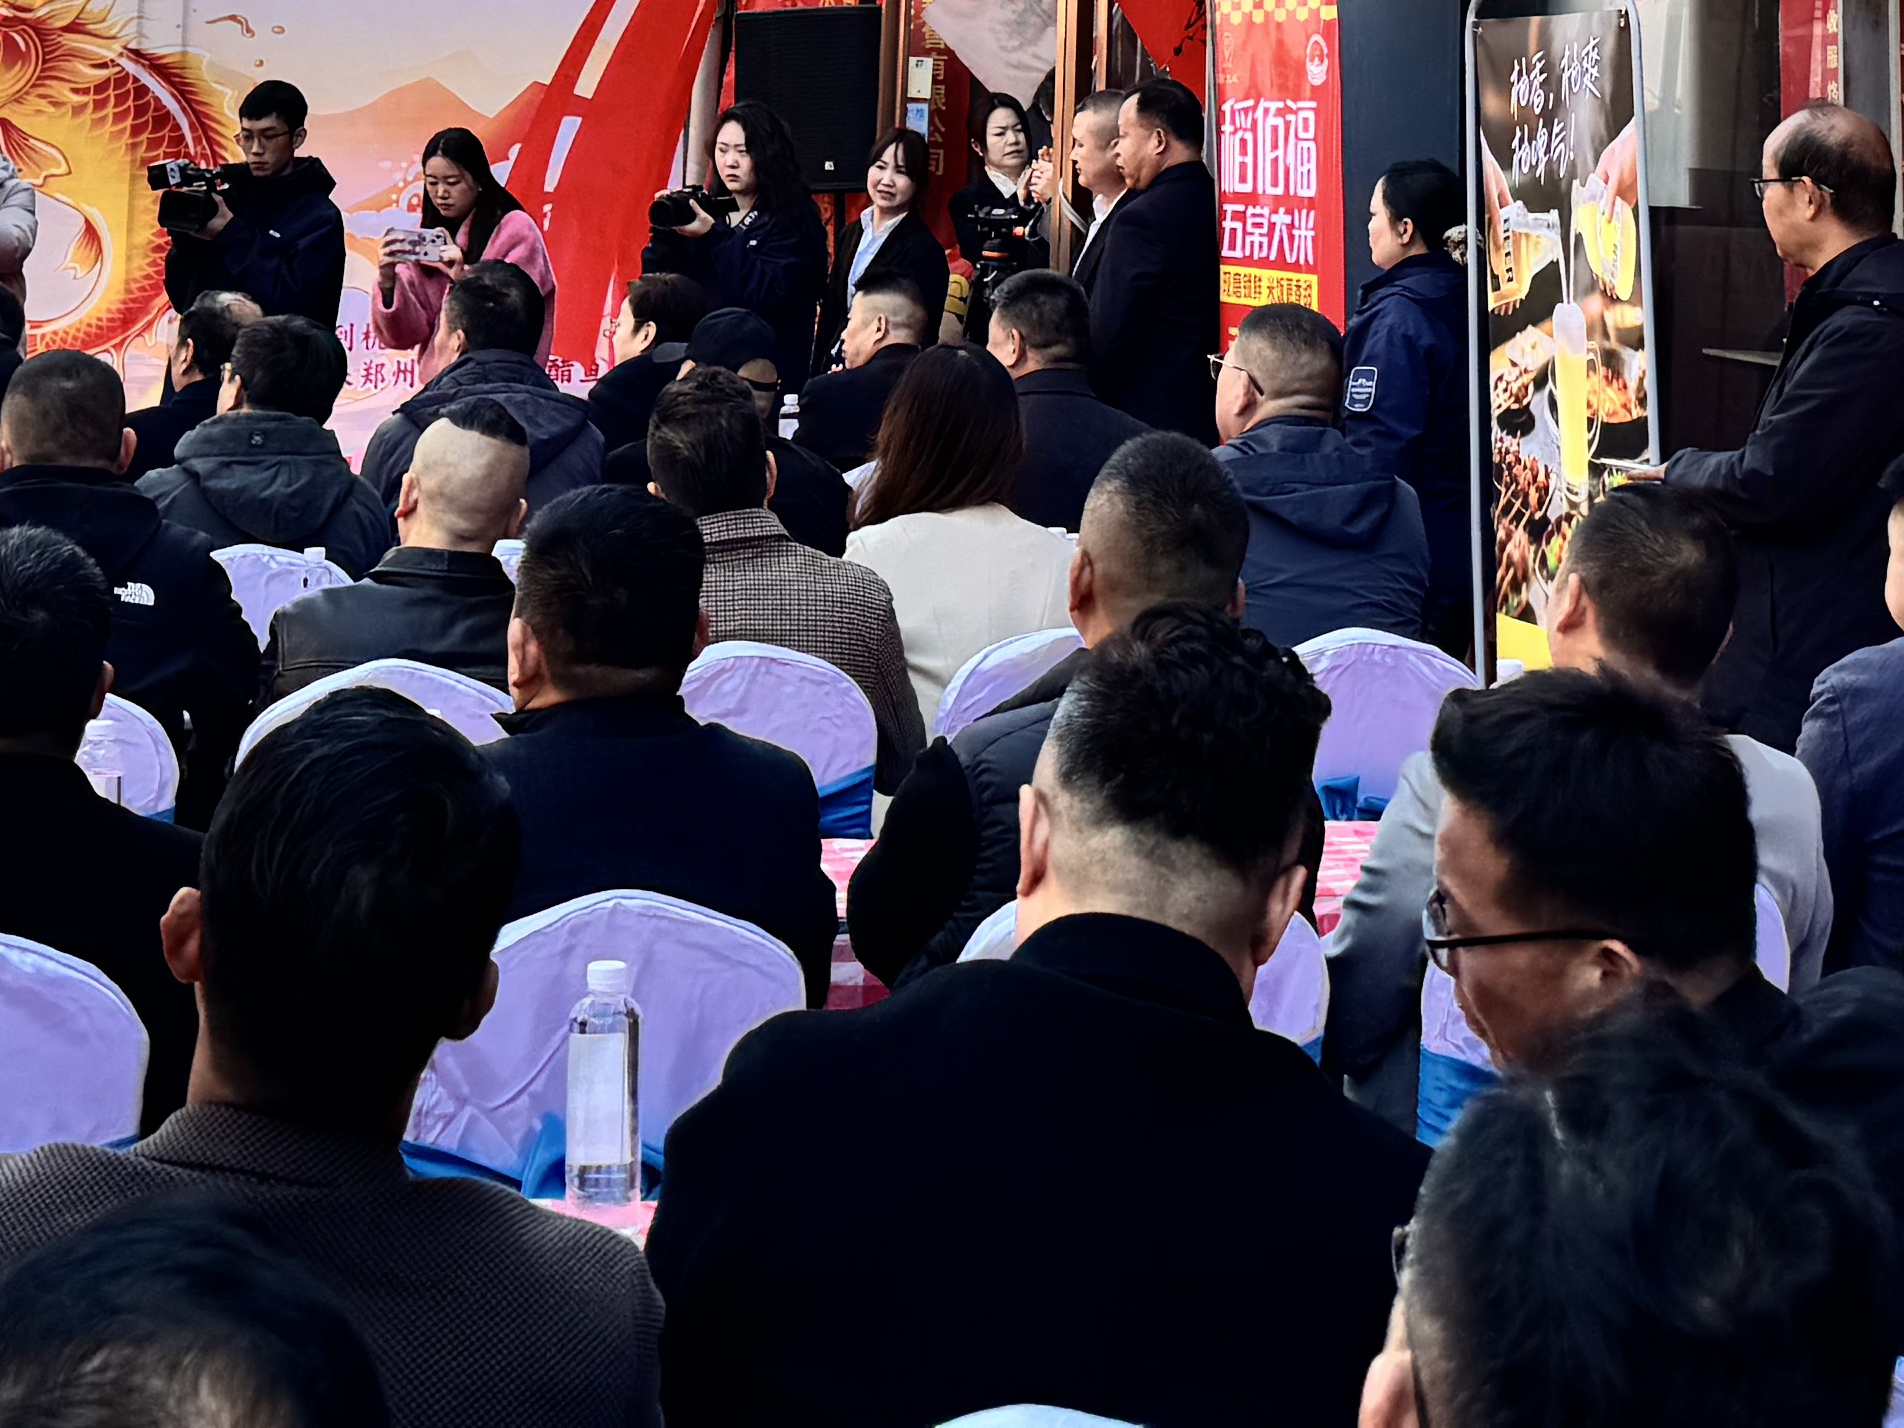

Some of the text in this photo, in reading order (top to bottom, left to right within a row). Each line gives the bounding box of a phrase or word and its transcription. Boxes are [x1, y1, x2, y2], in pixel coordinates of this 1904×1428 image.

[1220, 96, 1318, 198] 稻佰福
[1220, 203, 1315, 266] 五常大米
[1222, 270, 1263, 303] 现磨锁鲜
[345, 359, 415, 390] 郑州
